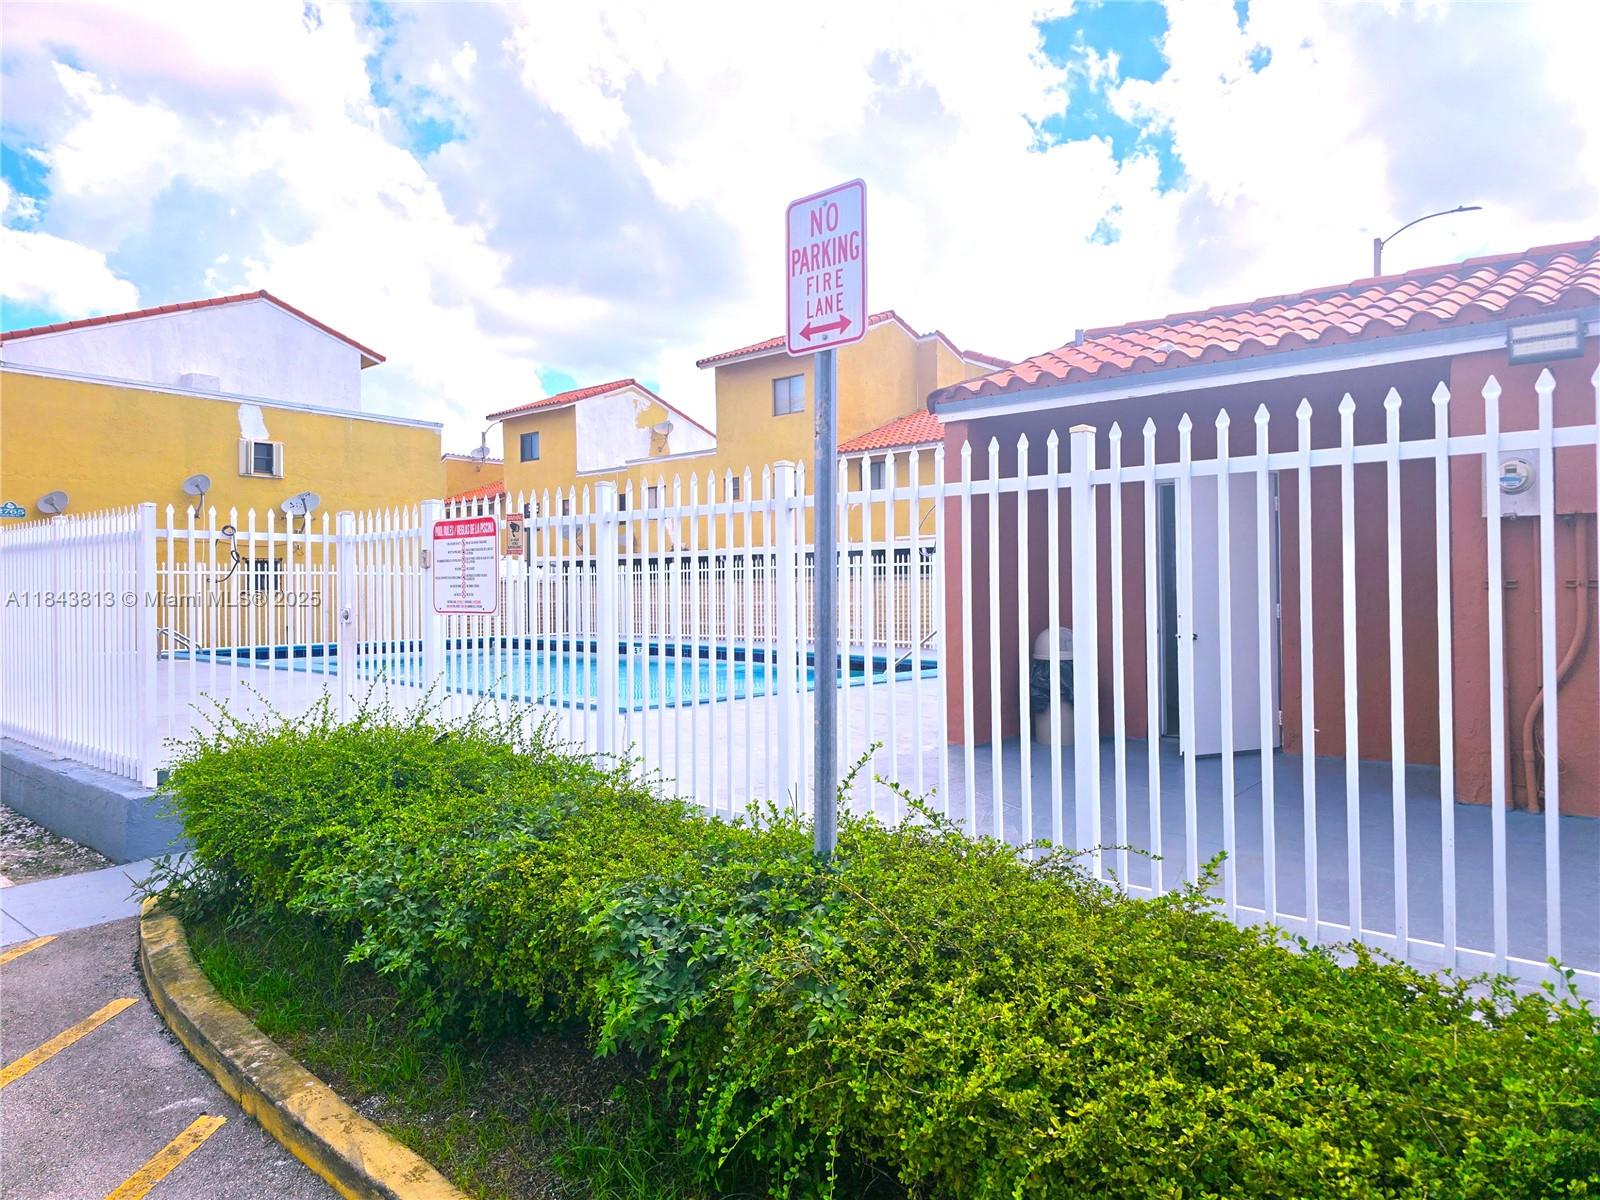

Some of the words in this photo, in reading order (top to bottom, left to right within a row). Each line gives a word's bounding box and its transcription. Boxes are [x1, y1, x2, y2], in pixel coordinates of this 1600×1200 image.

[810, 202, 839, 238] NO
[792, 230, 860, 277] PARKING
[806, 268, 844, 296] FIRE
[806, 292, 844, 319] LANE
